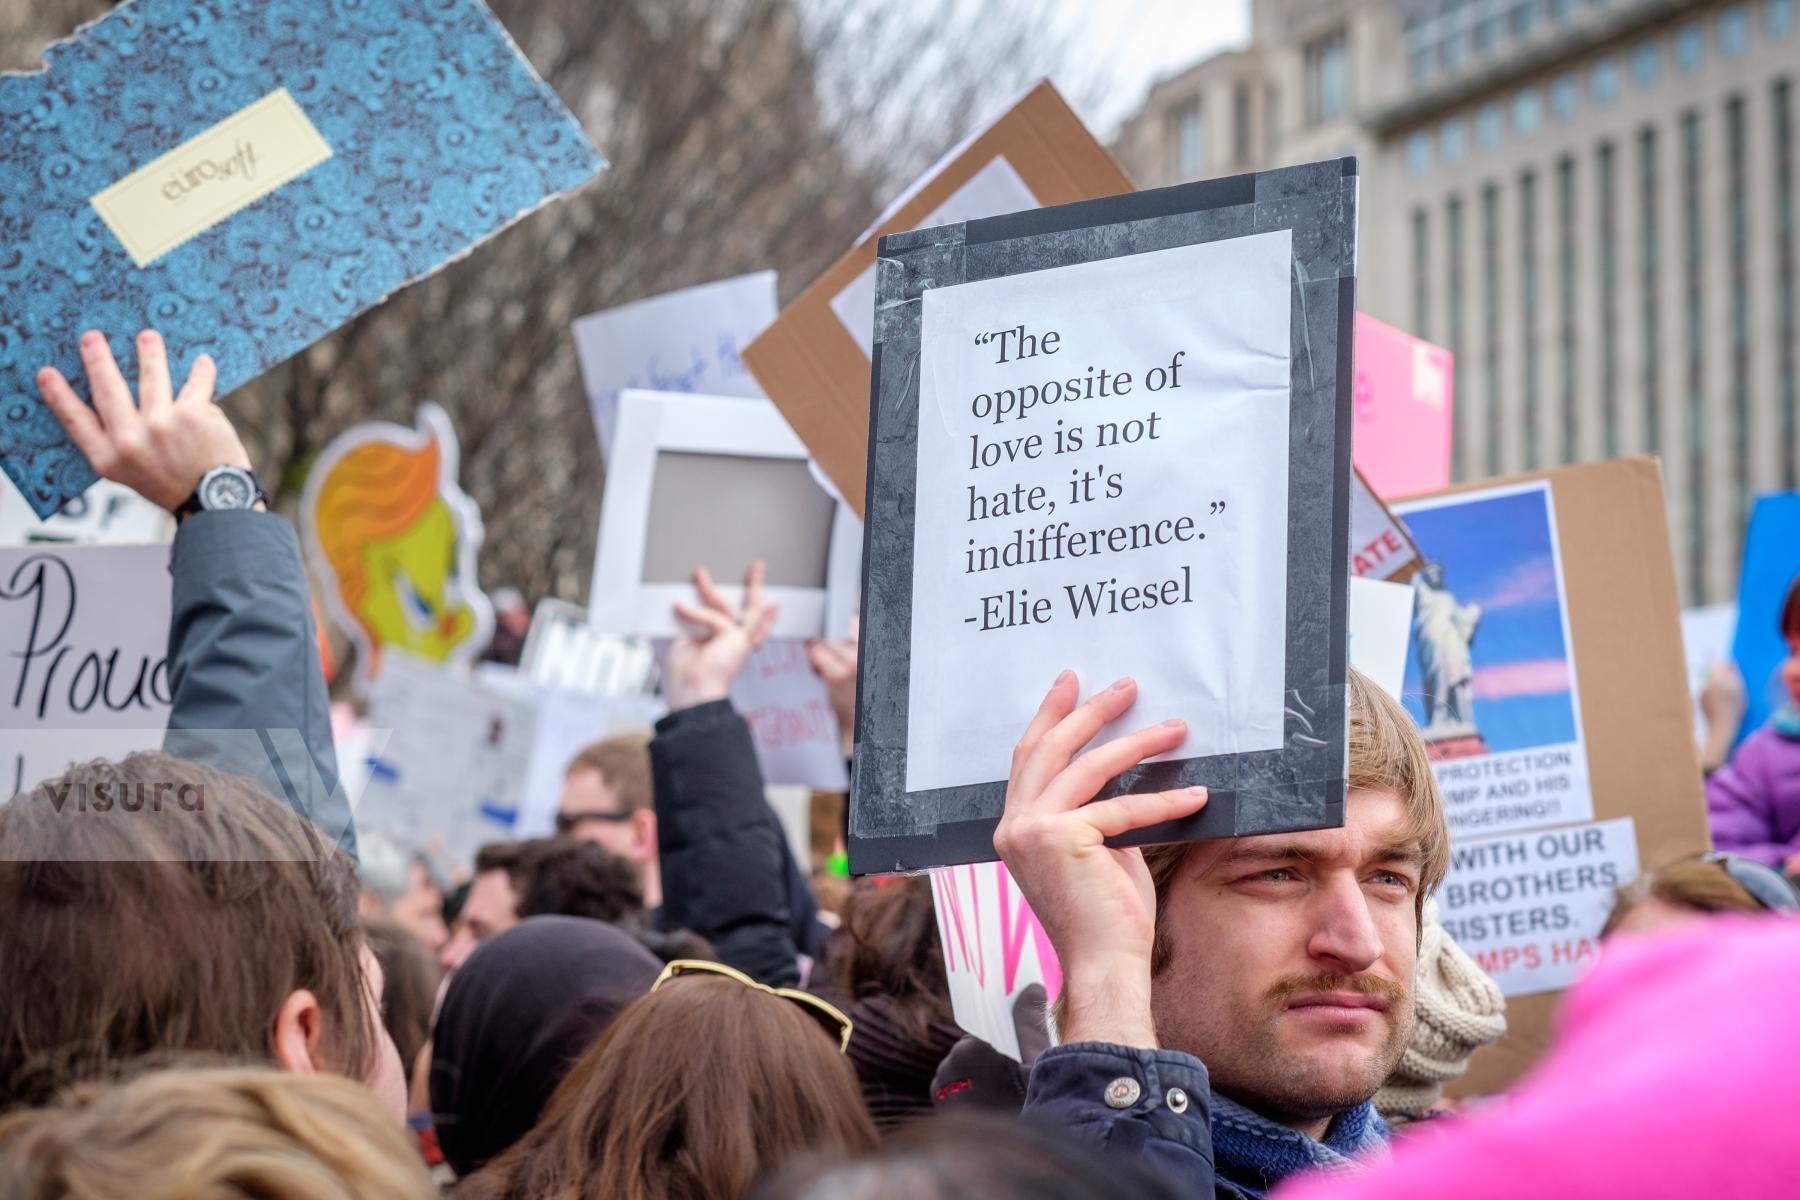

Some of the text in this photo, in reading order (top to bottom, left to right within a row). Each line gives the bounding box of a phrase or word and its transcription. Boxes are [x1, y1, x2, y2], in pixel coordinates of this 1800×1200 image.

[974, 324, 1061, 364] “The
[971, 351, 1186, 425] opposite of
[969, 411, 1162, 470] love is not
[966, 464, 1124, 522] hate, it's
[965, 501, 1226, 574] indifference.”
[964, 565, 1194, 632] -Elie Wiesel
[1438, 752, 1571, 781] PROTECTION
[1446, 773, 1571, 804] MP AND HIS
[1452, 828, 1605, 872] WITH OUR
[1446, 861, 1619, 909] BROTHERS
[1441, 903, 1579, 943] SISTERS.
[1469, 934, 1604, 974] MPS HA
